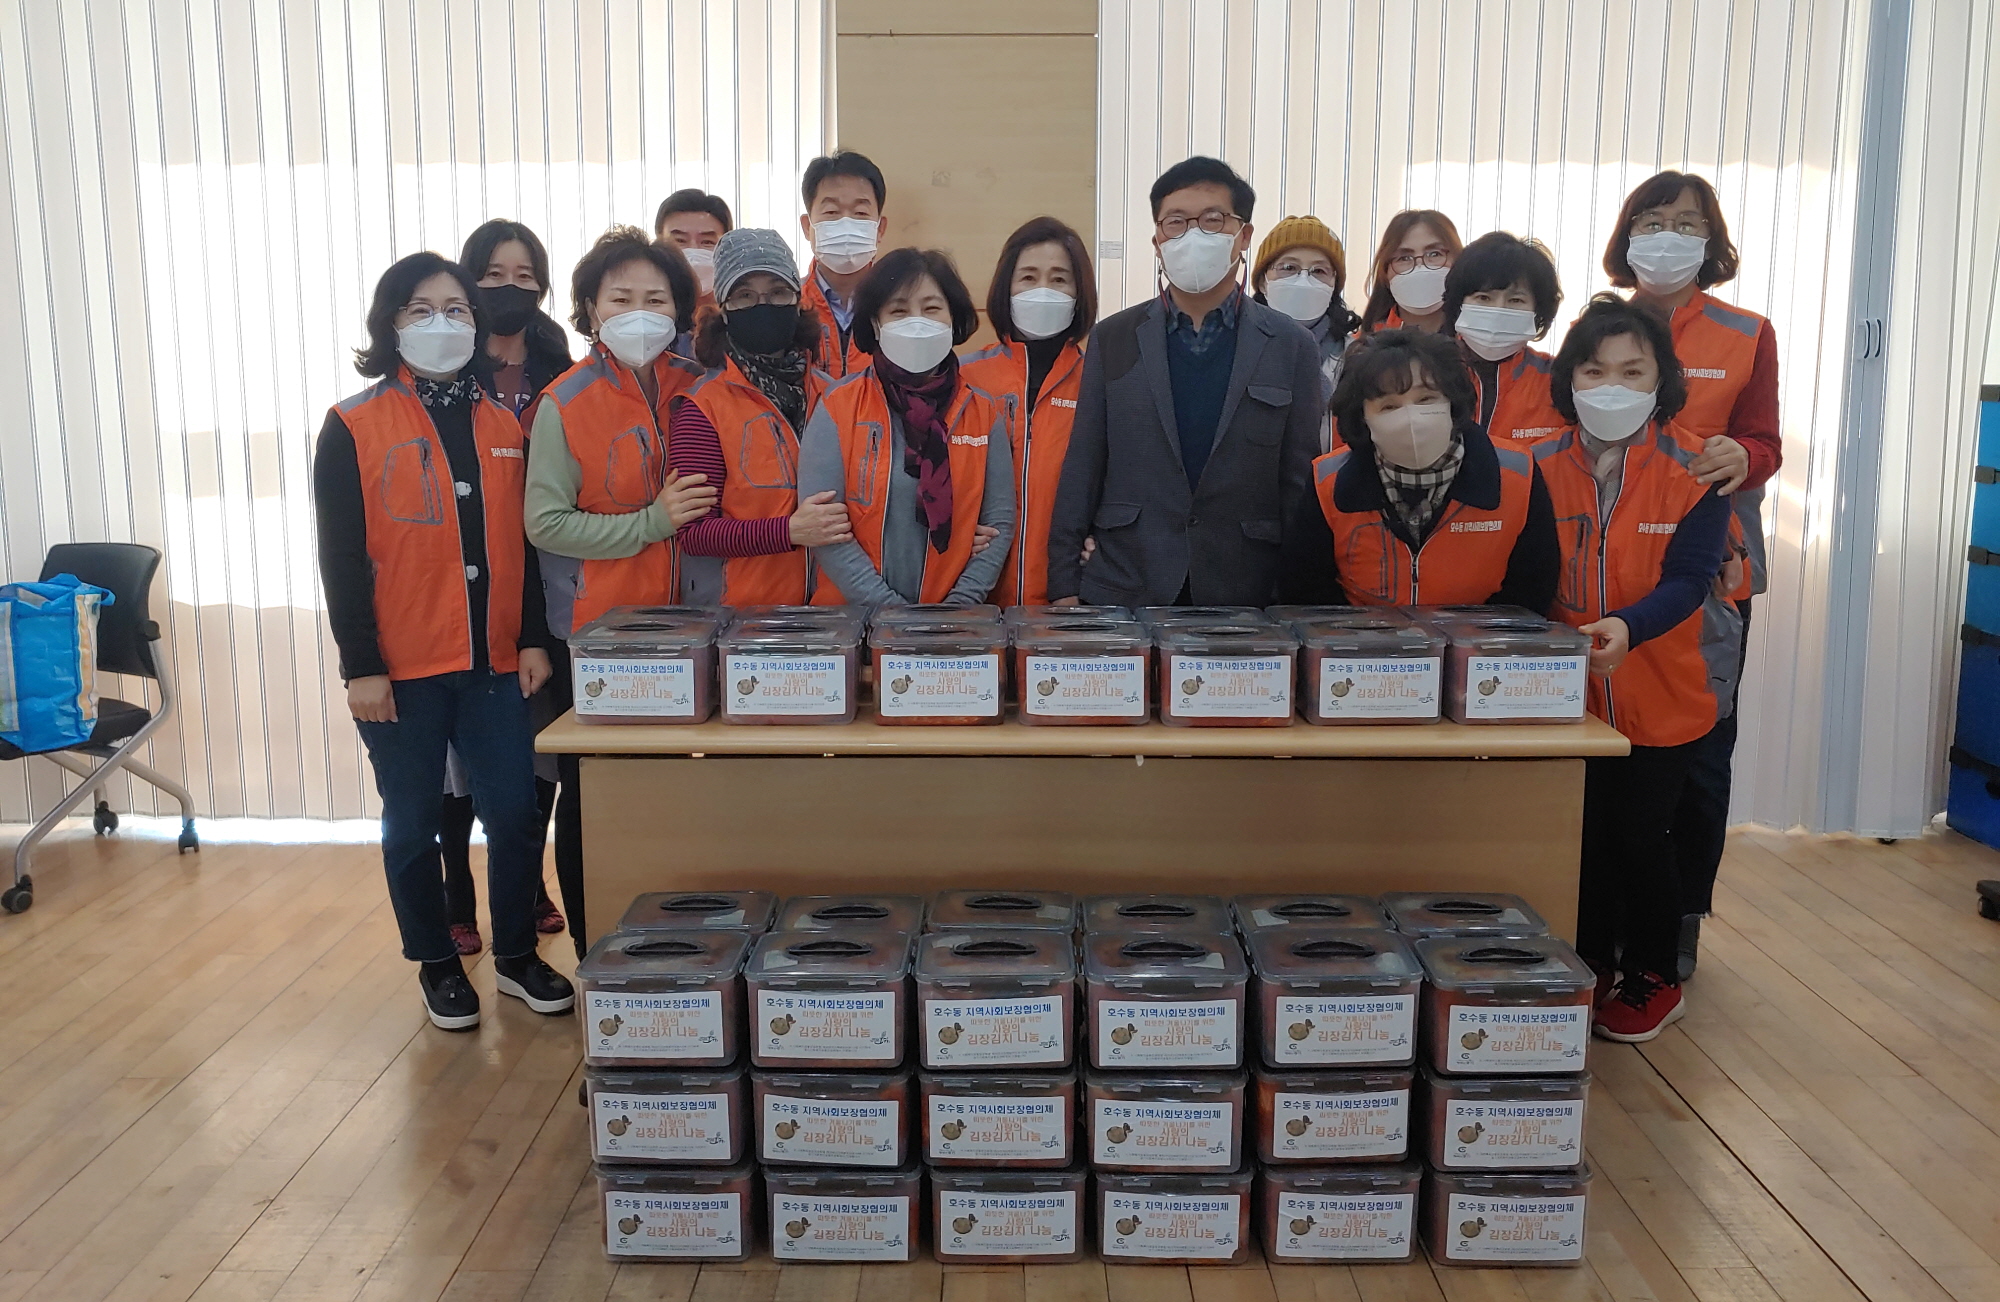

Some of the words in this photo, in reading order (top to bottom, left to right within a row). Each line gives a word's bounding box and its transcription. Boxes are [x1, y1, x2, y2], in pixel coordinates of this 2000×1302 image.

[581, 664, 604, 673] 호수동
[608, 663, 683, 673] 지역사회보장협의체
[733, 661, 757, 670] 호수동
[761, 661, 835, 670] 지역사회보장협의체
[888, 661, 911, 669] 호수동
[915, 660, 988, 669] 지역사회보장협의체
[1033, 663, 1057, 671] 호수동
[1061, 662, 1134, 671] 지역사회보장협의체
[1178, 661, 1203, 670] 호수동
[1206, 661, 1281, 670] 지역사회보장협의체
[1328, 664, 1353, 672] 호수동
[1356, 663, 1430, 672] 지역사회보장협의체
[1475, 662, 1500, 671] 호수동
[1503, 661, 1576, 670] 지역사회보장협의체
[631, 681, 655, 690] 사랑의
[784, 678, 807, 687] 사랑의
[937, 677, 961, 686] 사랑의
[1083, 679, 1107, 688] 사랑의
[1229, 678, 1253, 687] 사랑의
[1379, 680, 1403, 689] 사랑의
[1525, 678, 1549, 687] 사랑의
[610, 689, 648, 698] 김장김치
[653, 689, 672, 698] 나눔
[762, 687, 800, 696] 김장김치
[805, 686, 824, 695] 나눔
[916, 685, 954, 695] 김장김치
[959, 685, 977, 694] 나눔
[1062, 687, 1100, 697] 김장김치
[1105, 687, 1123, 696] 나눔
[1207, 686, 1245, 696] 김장김치
[1250, 686, 1269, 695] 나눔
[1356, 688, 1395, 698] 김장김치
[1400, 688, 1418, 697] 나눔
[1503, 686, 1541, 696] 김장김치
[1546, 686, 1564, 695] 나눔
[594, 999, 621, 1008] 호수동
[625, 998, 709, 1008] 지역사회보장협의체
[766, 997, 793, 1008] 호수동
[798, 997, 883, 1009] 지역사회보장협의체
[1285, 1003, 1313, 1013] 호수동
[1317, 1002, 1403, 1013] 지역사회보장협의체
[933, 1007, 961, 1017] 호수동
[965, 1003, 1051, 1016] 지역사회보장협의체
[1107, 1008, 1135, 1017] 호수동
[1139, 1006, 1225, 1017] 지역사회보장협의체
[651, 1017, 678, 1027] 사랑의
[824, 1017, 851, 1027] 사랑의
[1458, 1012, 1487, 1022] 호수동
[1491, 1012, 1577, 1023] 지역사회보장협의체
[992, 1023, 1020, 1034] 사랑의
[1166, 1026, 1193, 1035] 사랑의
[1343, 1021, 1371, 1031] 사랑의
[627, 1026, 671, 1037] 김장김치
[676, 1026, 698, 1036] 나눔
[799, 1026, 843, 1037] 김장김치
[848, 1027, 870, 1037] 나눔
[1318, 1030, 1362, 1041] 김장김치
[1368, 1029, 1389, 1039] 나눔
[1516, 1032, 1544, 1041] 사랑의
[967, 1033, 1012, 1045] 김장김치
[1017, 1031, 1039, 1042] 나눔
[1141, 1035, 1185, 1046] 김장김치
[1190, 1034, 1212, 1044] 나눔
[1490, 1041, 1535, 1051] 김장김치
[1541, 1040, 1562, 1050] 나눔
[602, 1100, 628, 1109] 호수동
[632, 1099, 716, 1110] 지역사회보장협의체
[937, 1103, 964, 1113] 호수동
[968, 1103, 1053, 1114] 지역사회보장협의체
[1283, 1100, 1311, 1110] 호수동
[1315, 1097, 1398, 1109] 지역사회보장협의체
[771, 1103, 798, 1114] 호수동
[802, 1104, 887, 1118] 지역사회보장협의체
[1103, 1107, 1131, 1117] 호수동
[1135, 1107, 1221, 1120] 지역사회보장협의체
[1455, 1106, 1484, 1116] 호수동
[1487, 1106, 1572, 1117] 지역사회보장협의체
[659, 1118, 686, 1128] 사랑의
[1340, 1116, 1367, 1126] 사랑의
[635, 1127, 678, 1137] 김장김치
[683, 1127, 705, 1137] 나눔
[828, 1124, 855, 1134] 사랑의
[994, 1122, 1021, 1132] 사랑의
[1161, 1127, 1188, 1137] 사랑의
[1315, 1125, 1358, 1136] 김장김치
[1364, 1124, 1385, 1134] 나눔
[1512, 1125, 1540, 1135] 사랑의
[803, 1131, 846, 1143] 김장김치
[852, 1134, 873, 1144] 나눔
[970, 1131, 1013, 1141] 김장김치
[1019, 1131, 1040, 1141] 나눔
[1135, 1135, 1180, 1146] 김장김치
[1185, 1136, 1207, 1146] 나눔
[1487, 1134, 1531, 1144] 김장김치
[1536, 1134, 1558, 1144] 나눔
[613, 1199, 640, 1209] 호수동
[644, 1199, 728, 1210] 지역사회보장협의체
[782, 1202, 809, 1212] 호수동
[813, 1202, 897, 1214] 지역사회보장협의체
[949, 1198, 976, 1208] 호수동
[980, 1198, 1064, 1208] 지역사회보장협의체
[1112, 1199, 1140, 1209] 호수동
[1144, 1199, 1229, 1212] 지역사회보장협의체
[1287, 1199, 1315, 1209] 호수동
[1319, 1199, 1402, 1211] 지역사회보장협의체
[1457, 1201, 1486, 1211] 호수동
[1490, 1201, 1574, 1213] 지역사회보장협의체
[670, 1218, 697, 1227] 사랑의
[838, 1221, 865, 1231] 사랑의
[1006, 1216, 1033, 1226] 사랑의
[1169, 1219, 1197, 1228] 사랑의
[1343, 1218, 1370, 1228] 사랑의
[1514, 1221, 1542, 1230] 사랑의
[646, 1226, 689, 1236] 김장김치
[695, 1227, 716, 1237] 나눔
[814, 1229, 857, 1240] 김장김치
[863, 1230, 884, 1240] 나눔
[981, 1225, 1024, 1235] 김장김치
[1030, 1225, 1051, 1235] 나눔
[1144, 1227, 1188, 1238] 김장김치
[1193, 1228, 1214, 1238] 나눔
[1318, 1227, 1362, 1237] 김장김치
[1367, 1227, 1388, 1237] 나눔
[1489, 1229, 1533, 1239] 김장김치
[1538, 1230, 1560, 1239] 나눔
